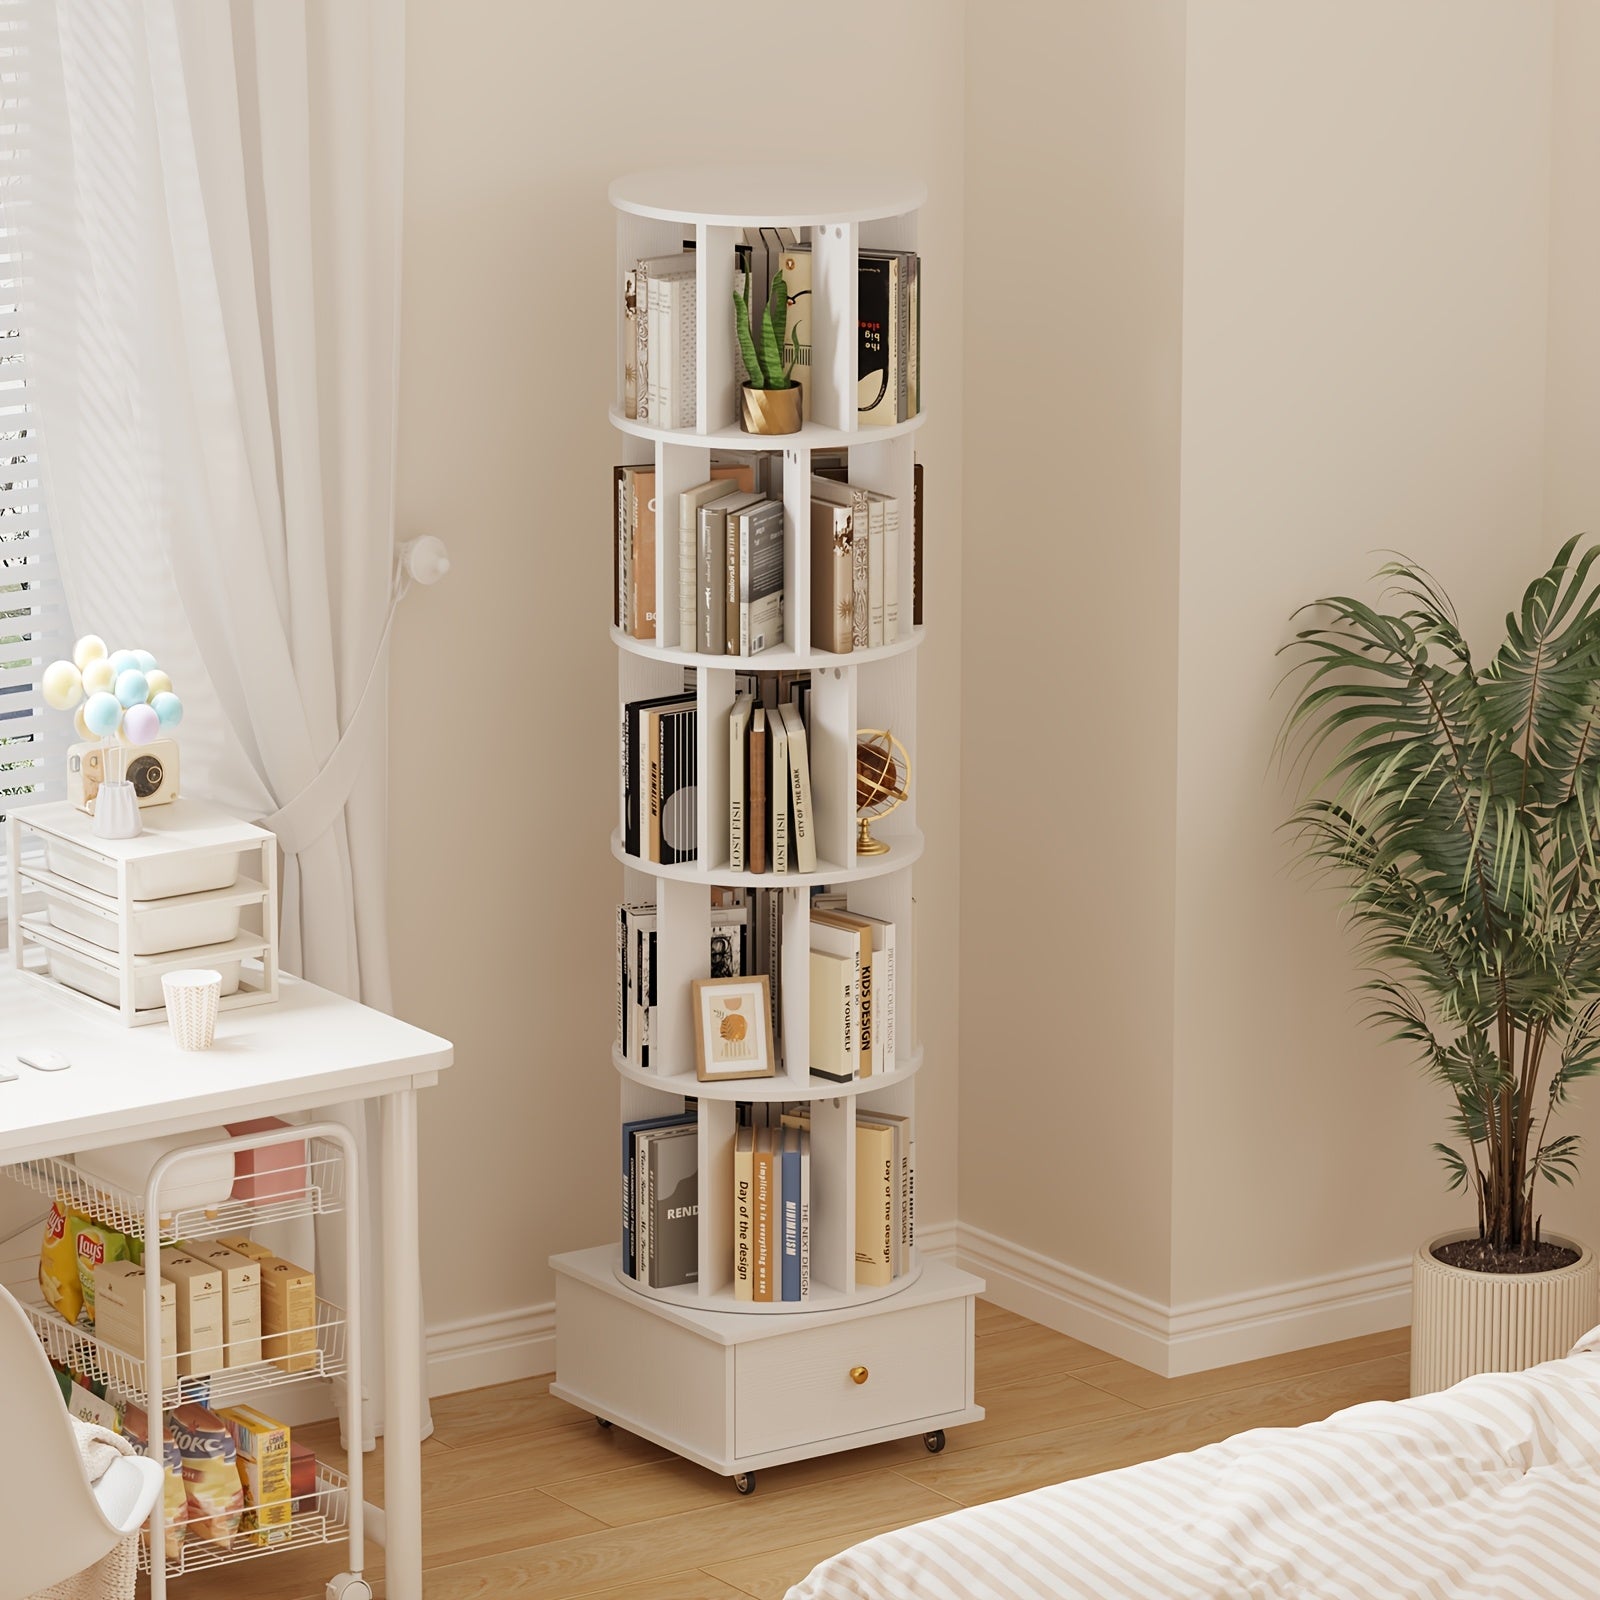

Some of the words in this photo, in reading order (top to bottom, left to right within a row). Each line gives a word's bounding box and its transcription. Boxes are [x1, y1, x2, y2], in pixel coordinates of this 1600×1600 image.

[858, 320, 880, 331] slee
[865, 330, 880, 342] big
[865, 342, 880, 351] the
[793, 768, 801, 788] DARK
[732, 801, 741, 830] FISH
[776, 813, 785, 838] FISH
[797, 809, 803, 819] OF
[732, 833, 741, 867] LOST
[776, 840, 785, 873] LOST
[845, 985, 851, 998] BE
[861, 965, 871, 998] KIDS
[861, 1001, 871, 1051] DESIGN
[758, 1161, 768, 1202] simplicity
[883, 1160, 891, 1183] Day
[737, 1181, 749, 1204] Day
[885, 1185, 891, 1198] of
[739, 1206, 749, 1219] of
[739, 1221, 749, 1240] the
[758, 1223, 768, 1266] everything
[883, 1224, 891, 1264] design
[737, 1242, 749, 1280] design
